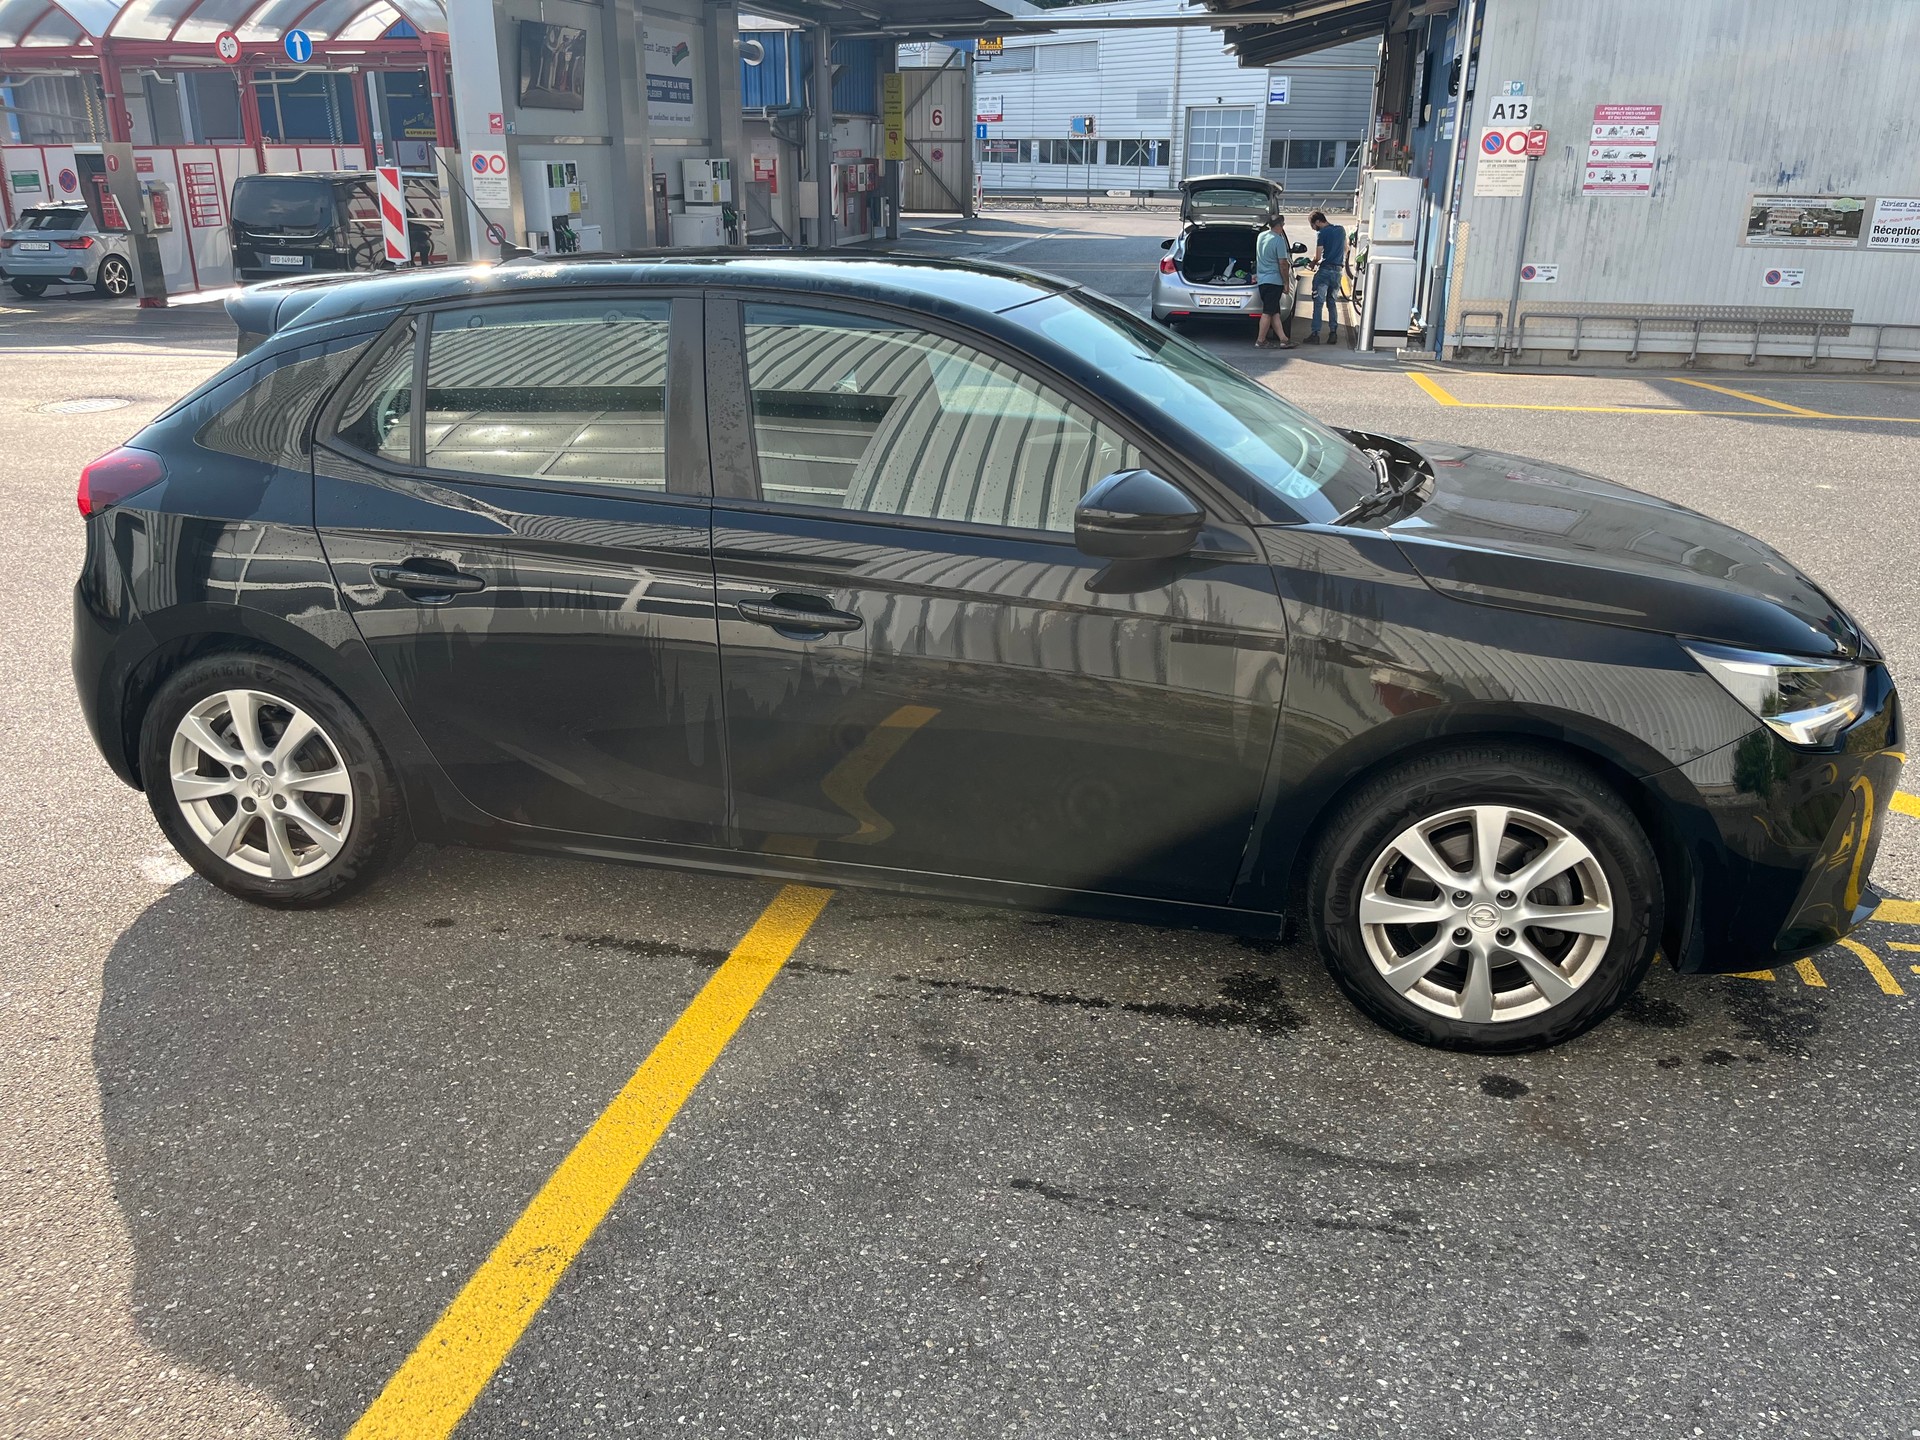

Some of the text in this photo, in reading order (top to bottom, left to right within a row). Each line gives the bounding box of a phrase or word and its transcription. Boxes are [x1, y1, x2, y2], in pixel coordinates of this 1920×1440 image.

[932, 109, 943, 126] 6
[1492, 103, 1528, 120] A13
[111, 158, 115, 170] 1
